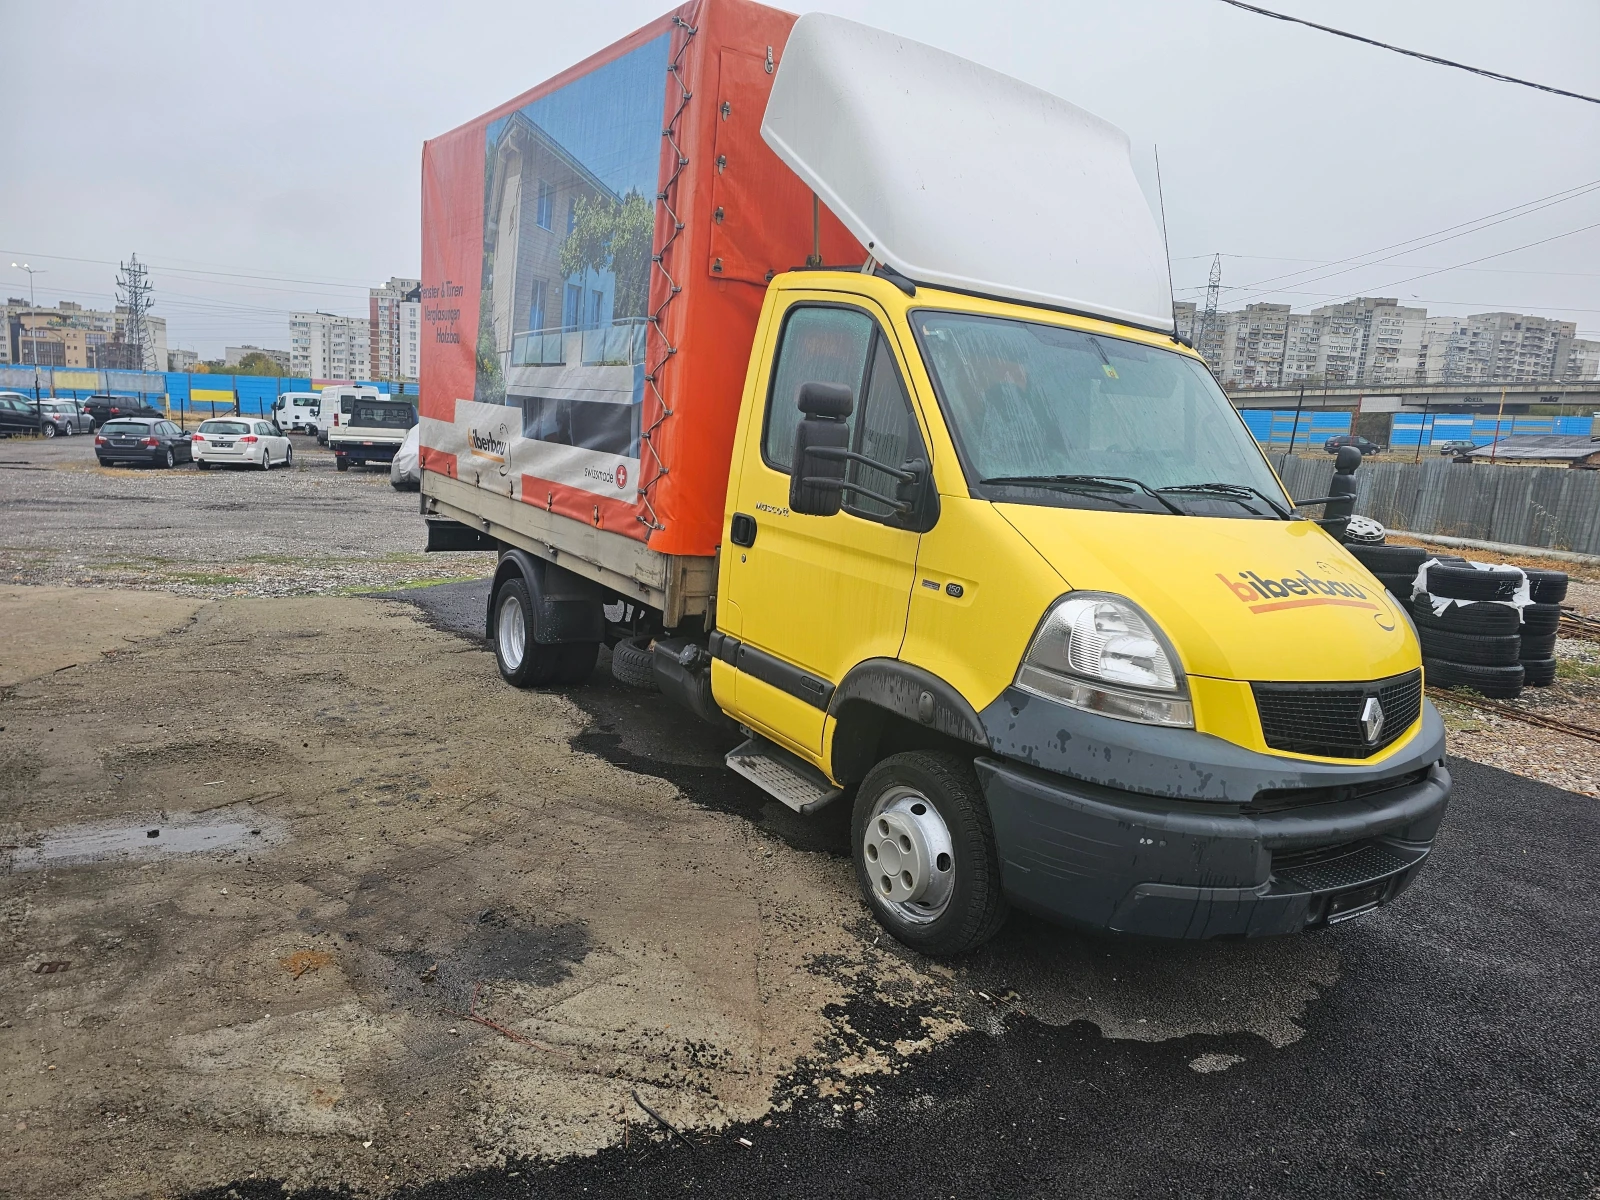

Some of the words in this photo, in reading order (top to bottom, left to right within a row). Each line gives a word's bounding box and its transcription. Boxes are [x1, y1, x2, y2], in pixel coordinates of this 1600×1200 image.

[446, 281, 464, 298] Türen
[424, 303, 461, 326] Verglasungen
[436, 325, 461, 344] Holzbau
[468, 427, 507, 456] biberbau
[584, 465, 614, 484] swissmade
[947, 584, 961, 594] 150
[1215, 569, 1368, 603] biberbau
